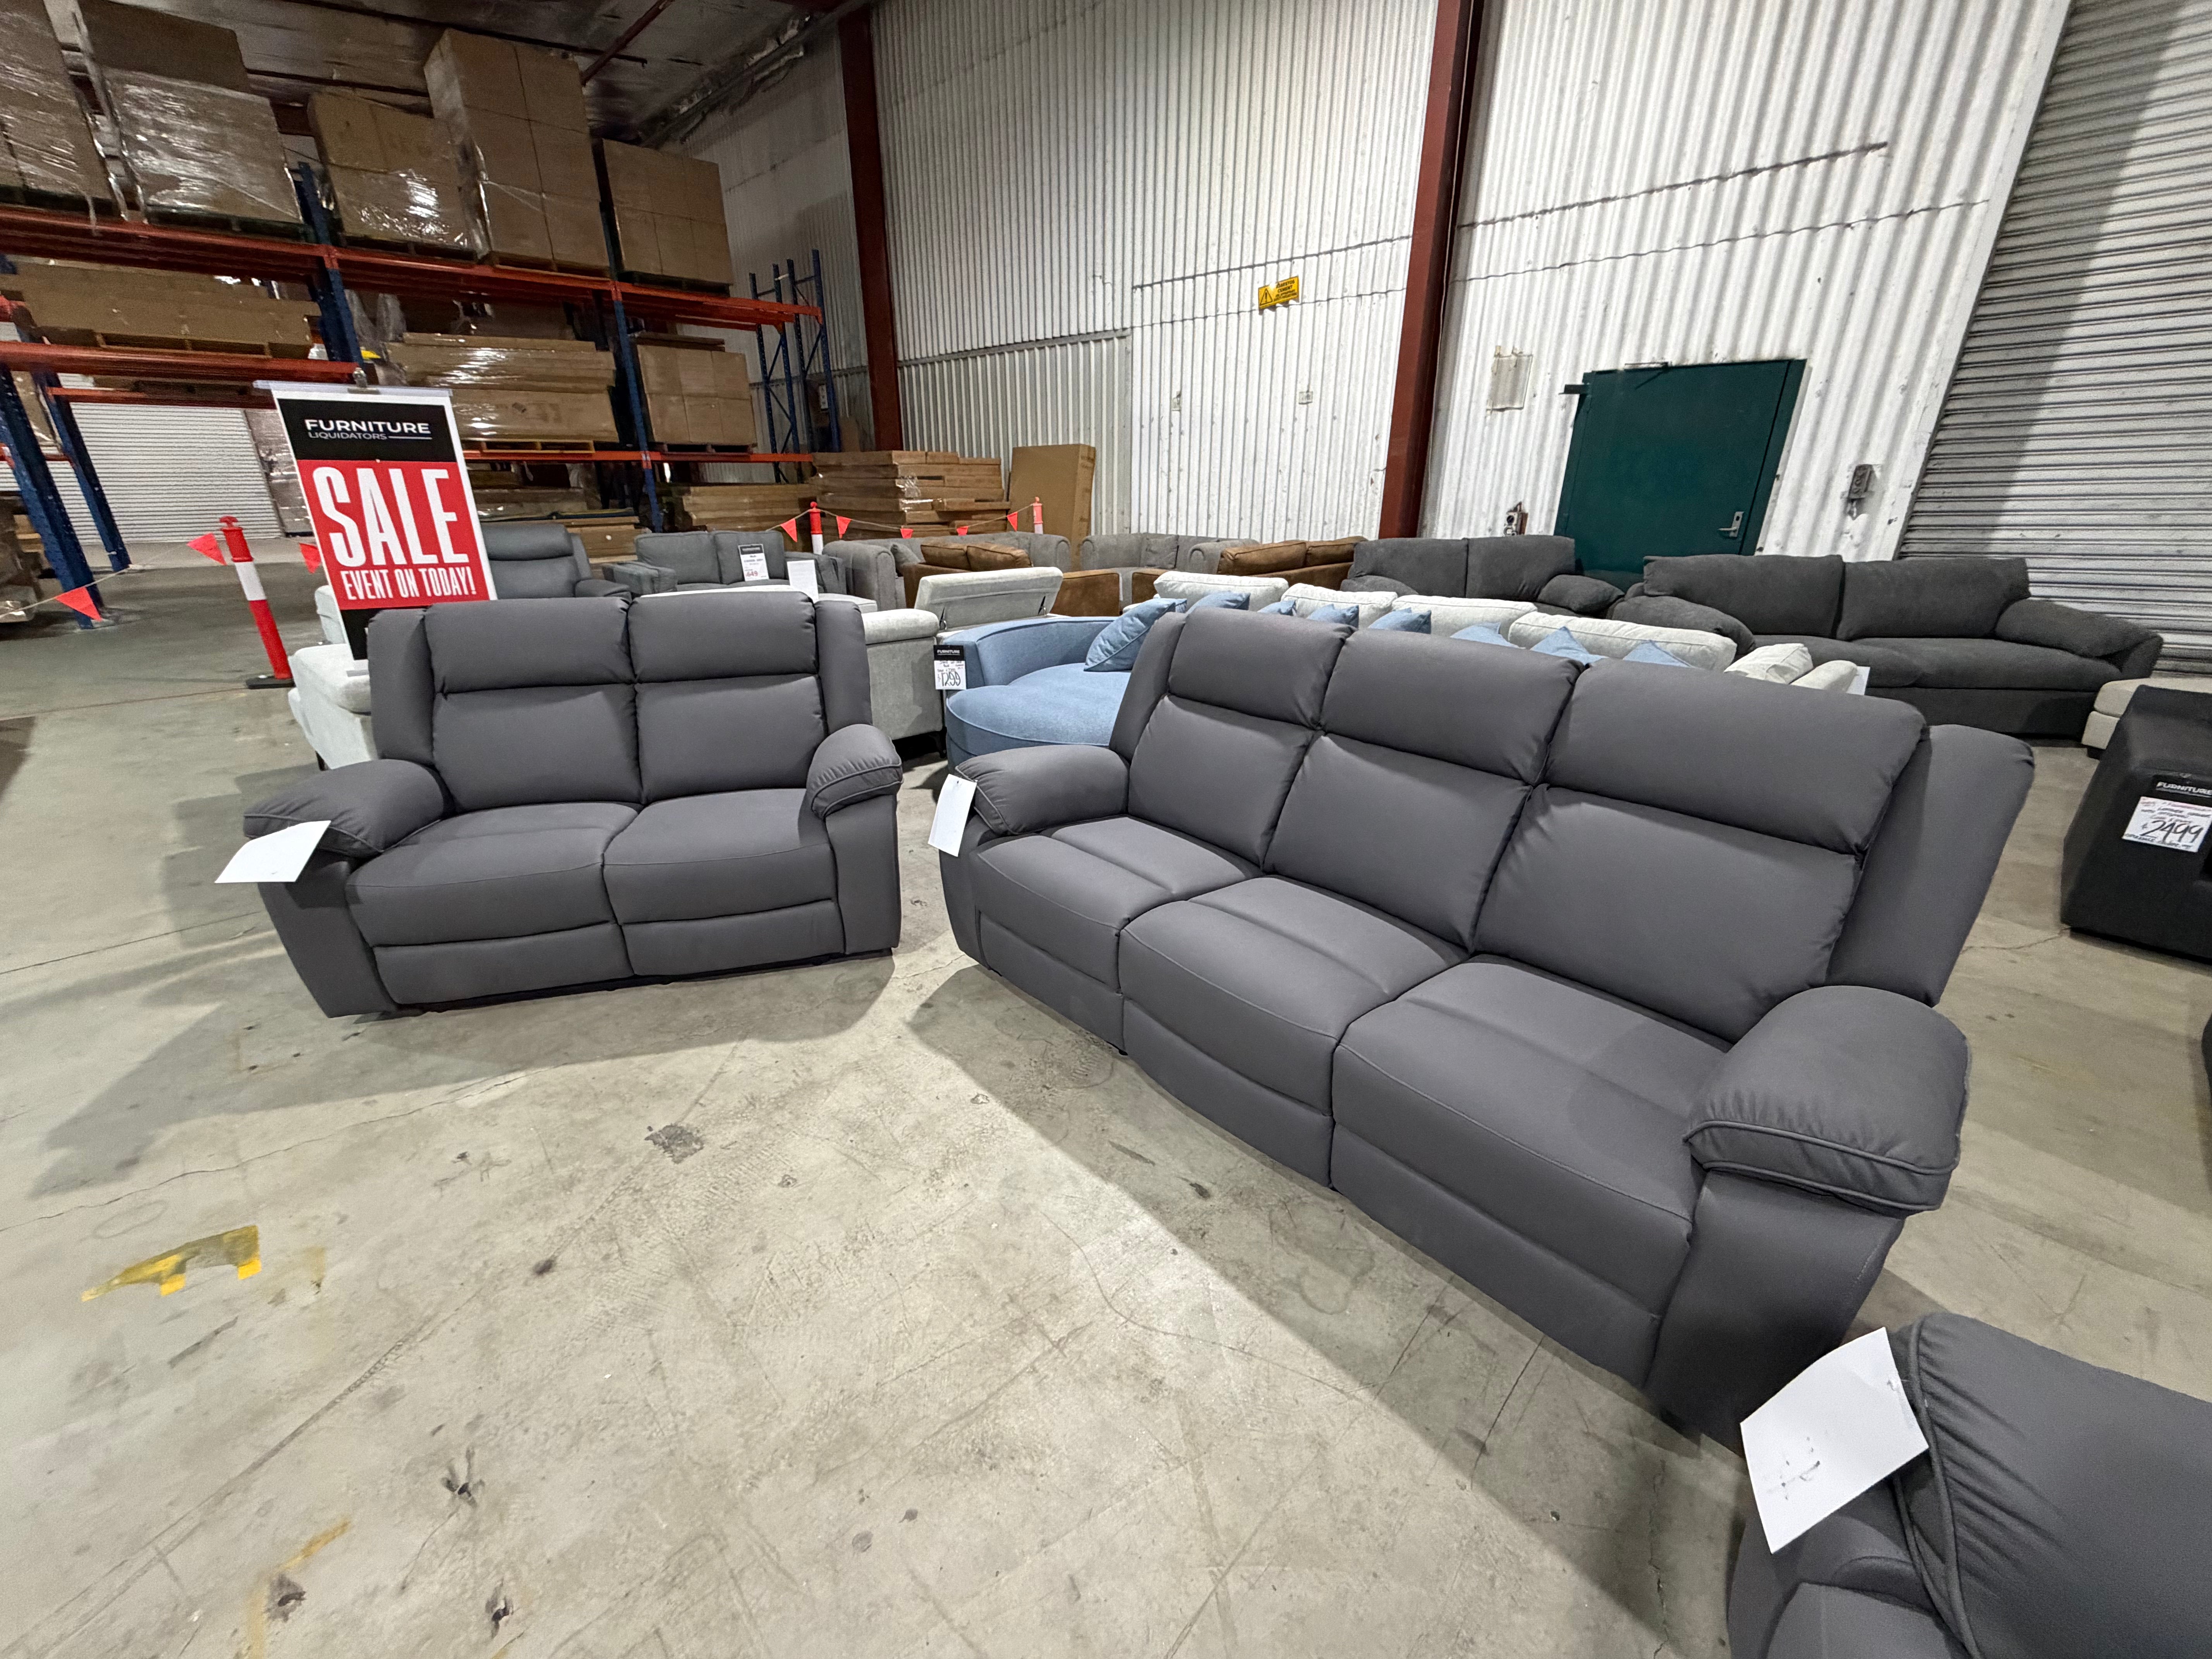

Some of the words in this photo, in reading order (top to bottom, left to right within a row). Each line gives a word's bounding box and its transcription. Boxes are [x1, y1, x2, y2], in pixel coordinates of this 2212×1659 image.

[304, 419, 431, 434] FURNITURE
[307, 432, 387, 440] LIQUIDATORS
[313, 466, 469, 567] SALE
[340, 570, 393, 600] EVENT
[394, 568, 421, 598] ON
[418, 566, 477, 596] TODAY!
